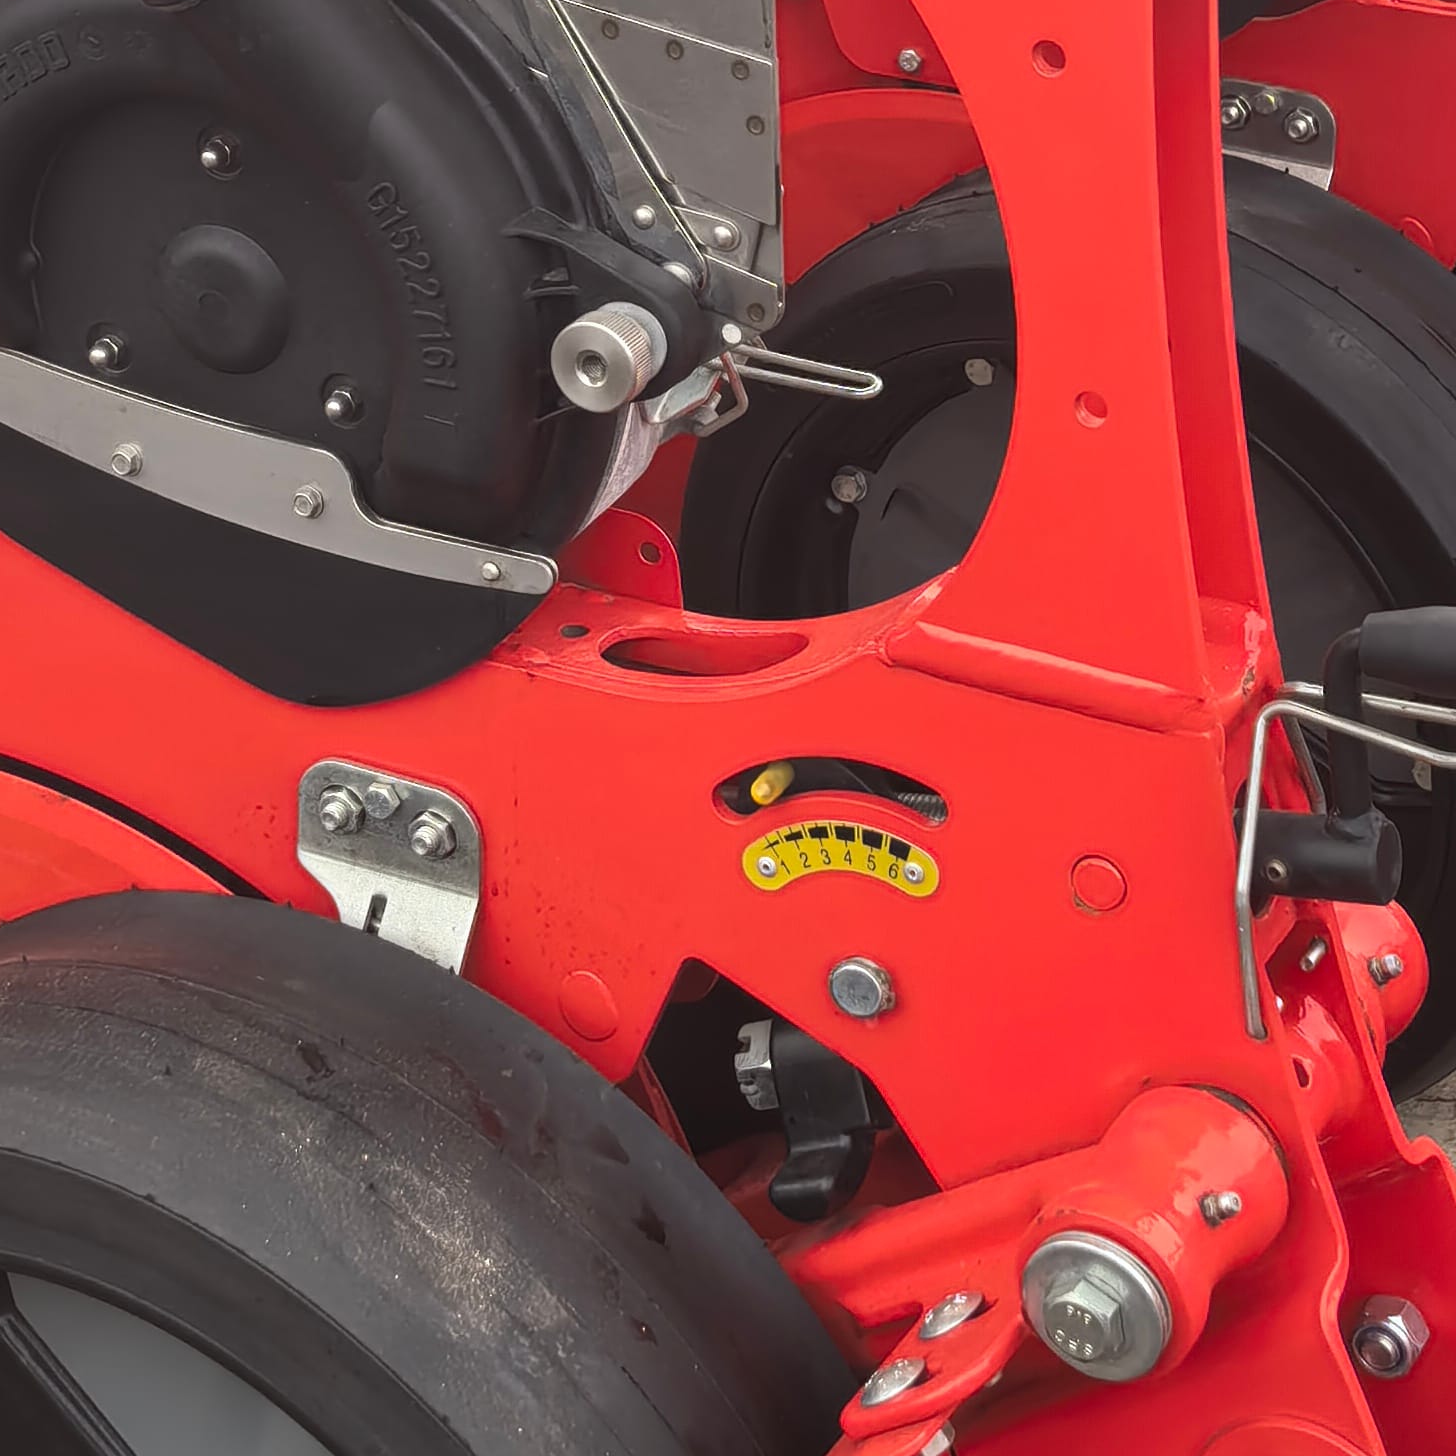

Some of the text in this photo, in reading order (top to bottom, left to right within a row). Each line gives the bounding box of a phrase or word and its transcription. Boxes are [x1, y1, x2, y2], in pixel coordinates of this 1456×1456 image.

[780, 849, 899, 879] 1 2 3 4 5 6
